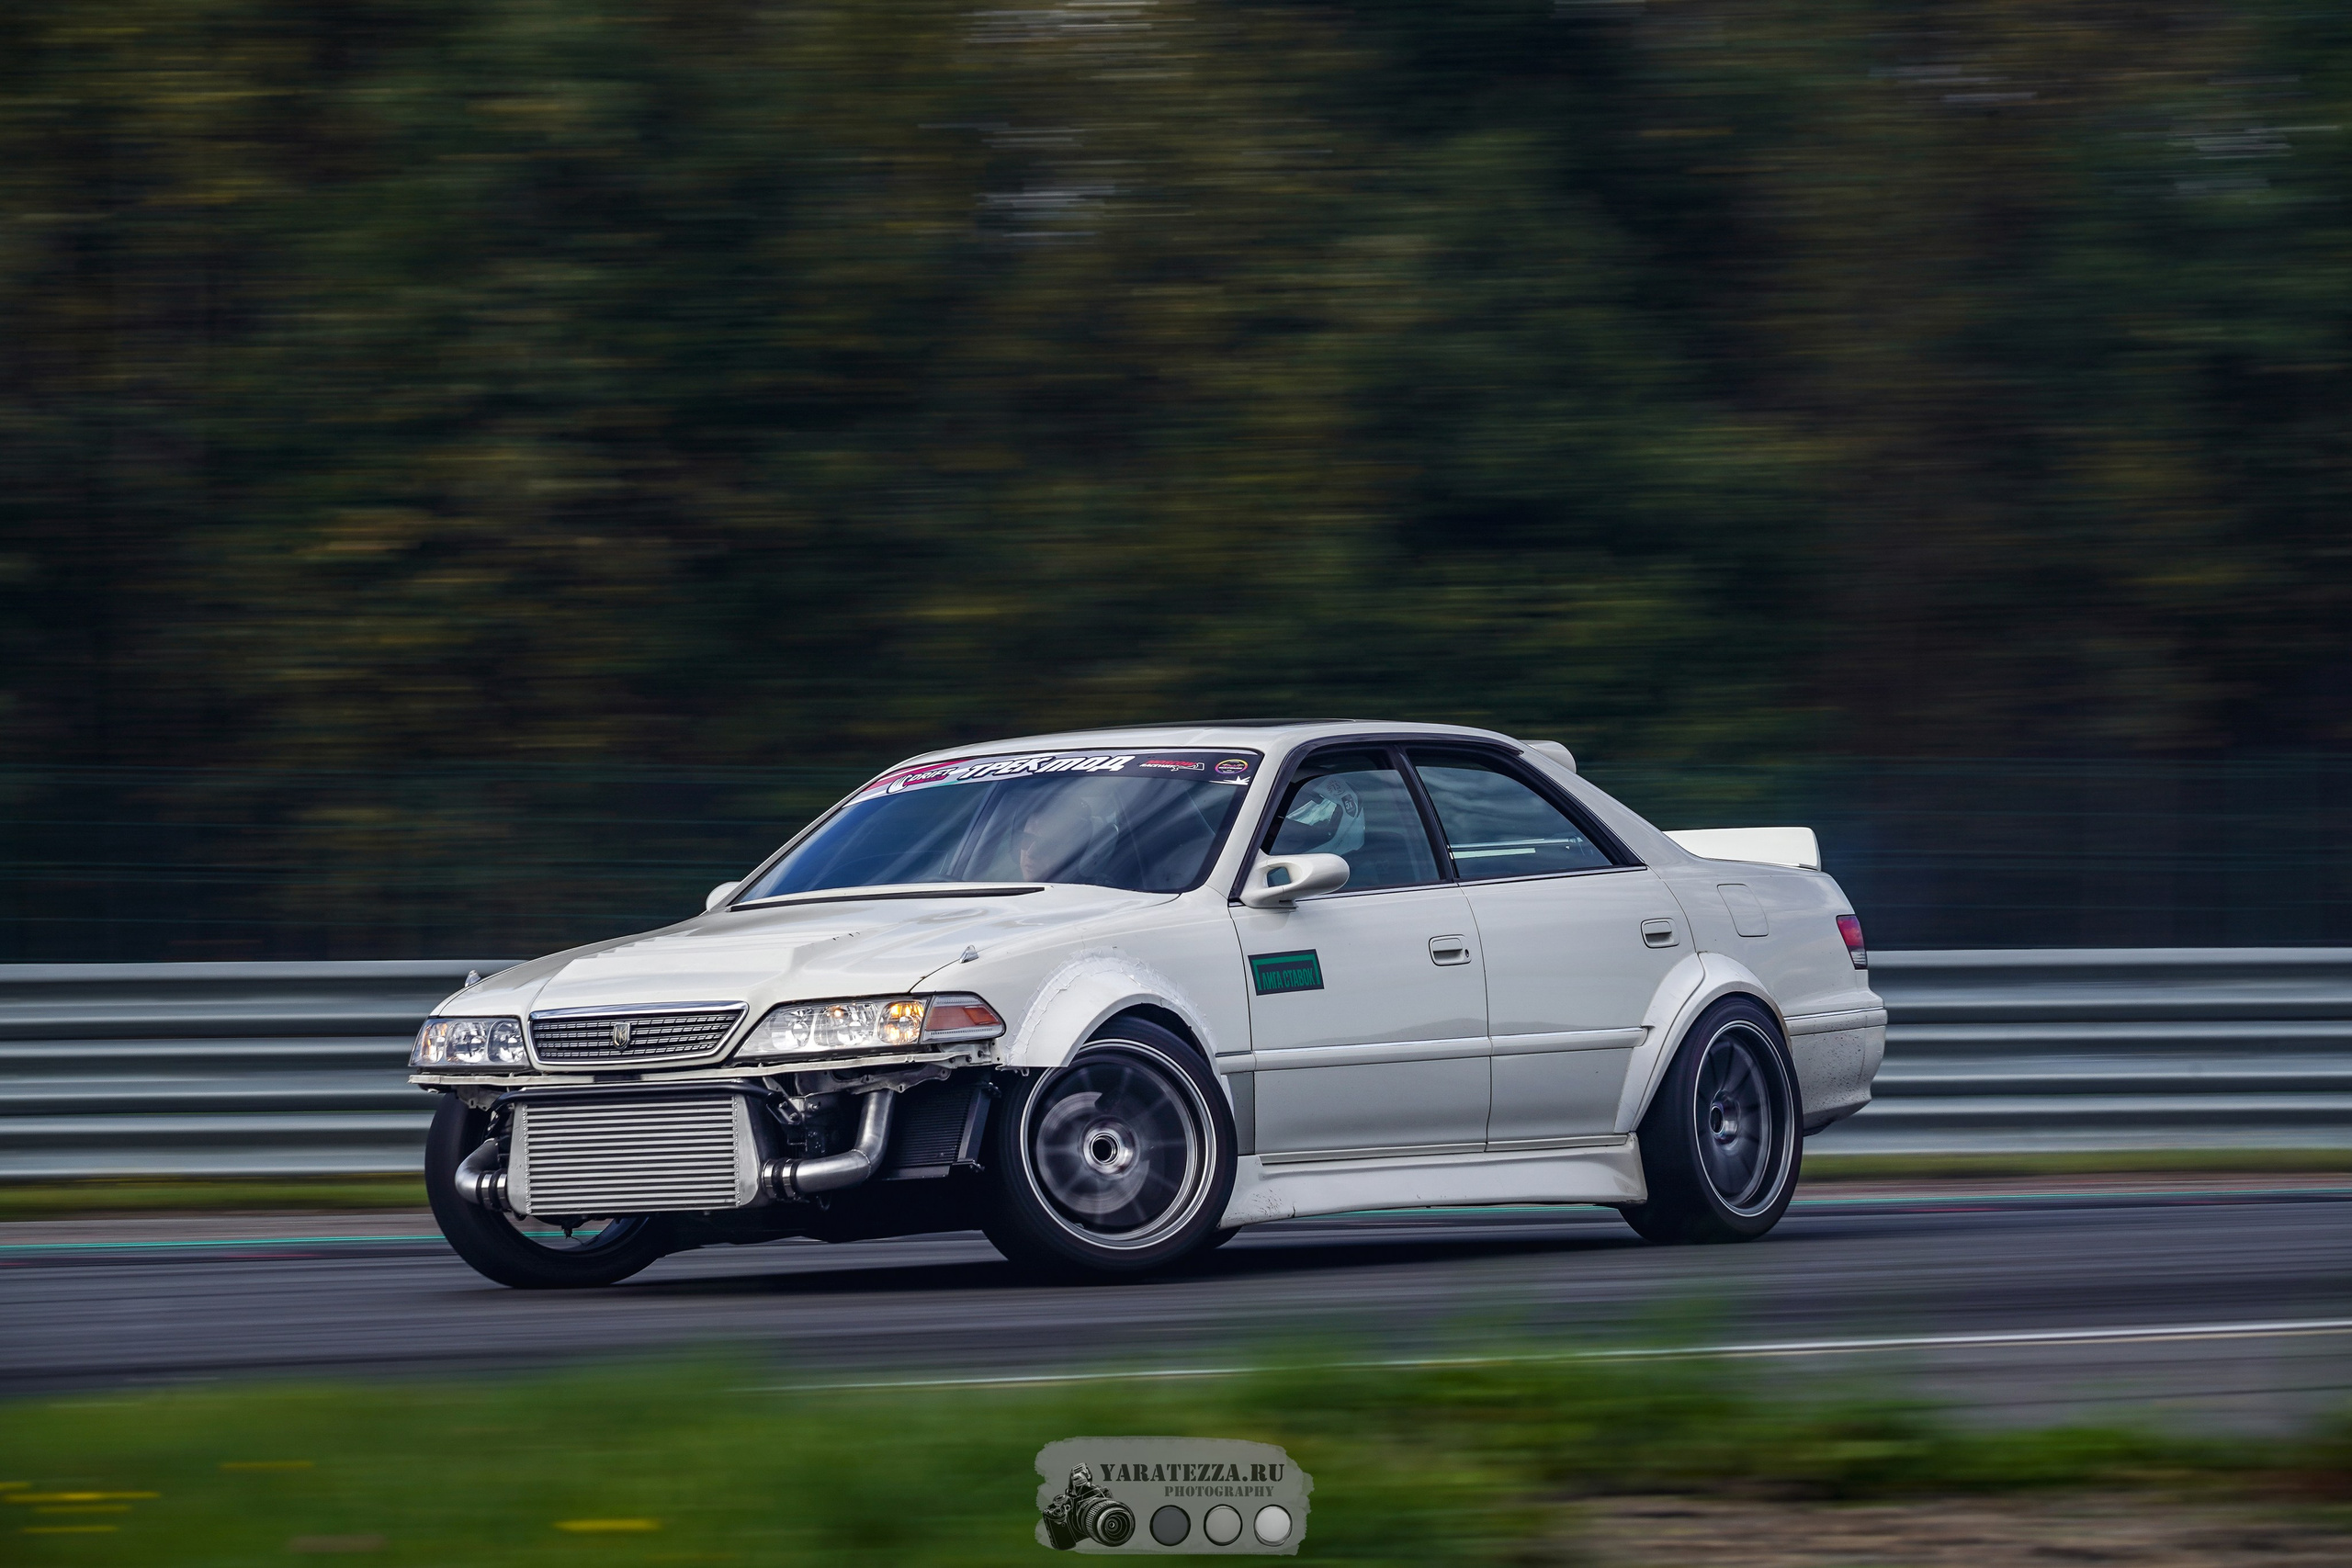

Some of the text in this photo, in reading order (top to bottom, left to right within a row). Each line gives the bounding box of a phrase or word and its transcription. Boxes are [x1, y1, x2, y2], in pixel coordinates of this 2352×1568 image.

[908, 767, 959, 782] DRIFT
[1261, 967, 1316, 990] ЛИГА СТАВОК
